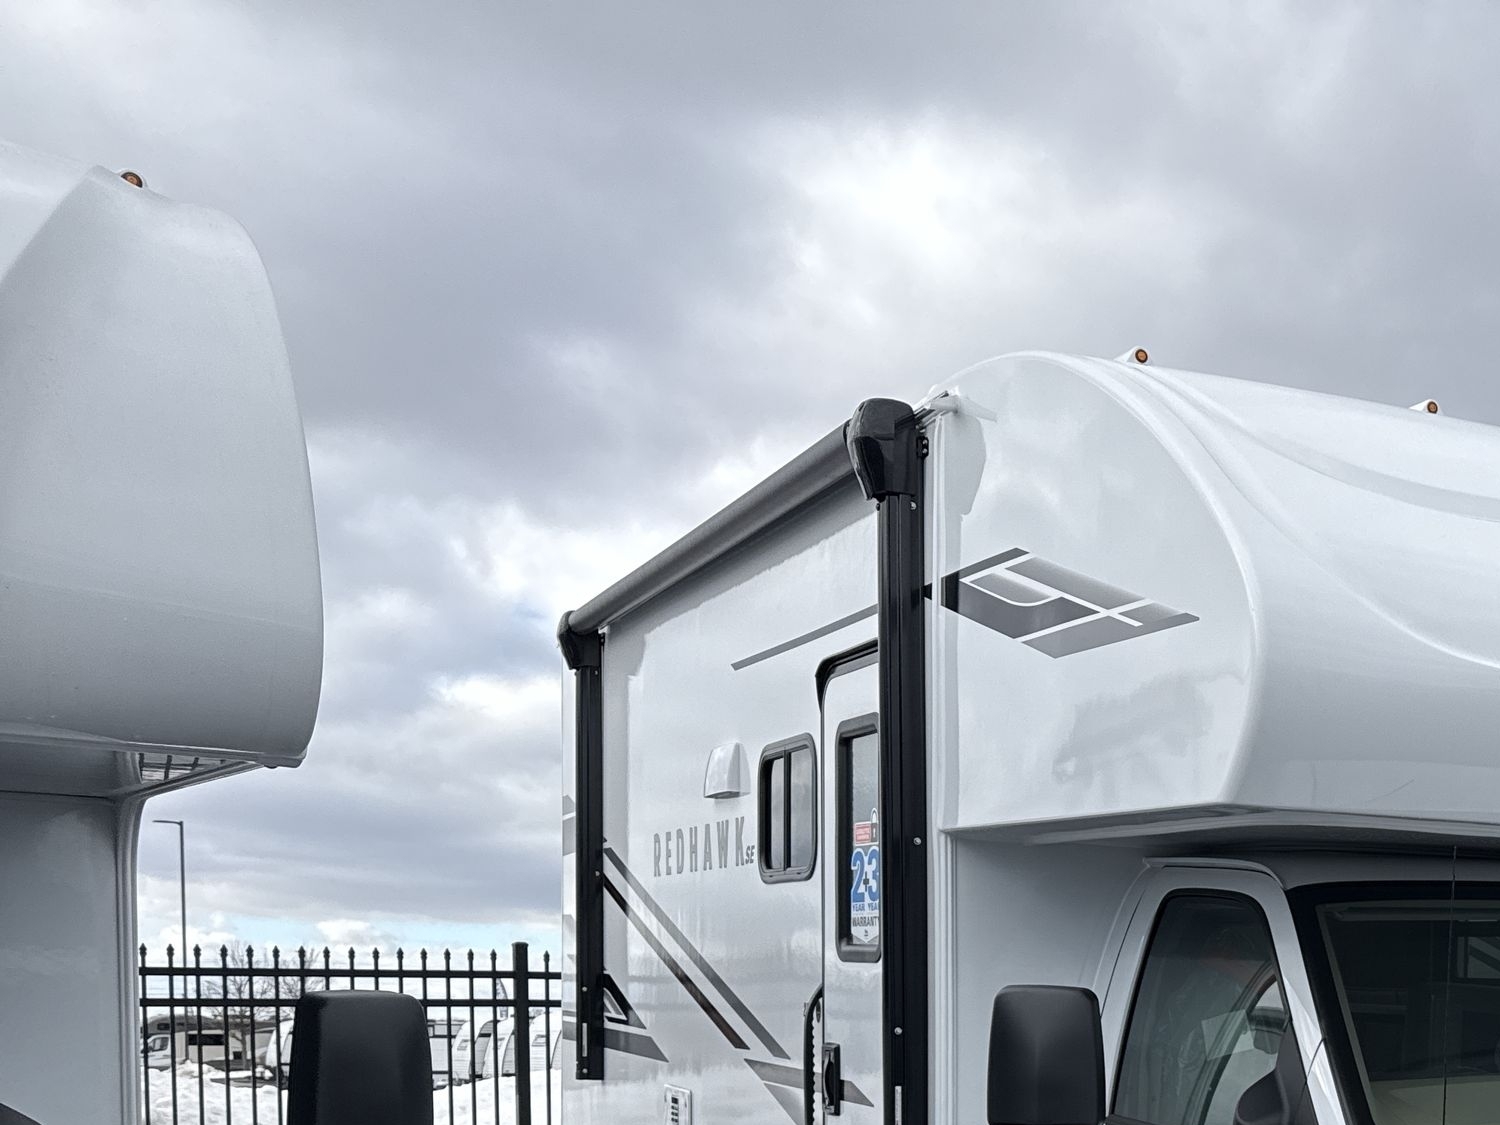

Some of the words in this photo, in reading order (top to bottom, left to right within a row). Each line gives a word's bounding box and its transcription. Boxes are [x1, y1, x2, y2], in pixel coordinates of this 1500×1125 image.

[653, 816, 745, 877] REDHAWK
[745, 845, 755, 864] SE
[867, 902, 879, 911] YEA
